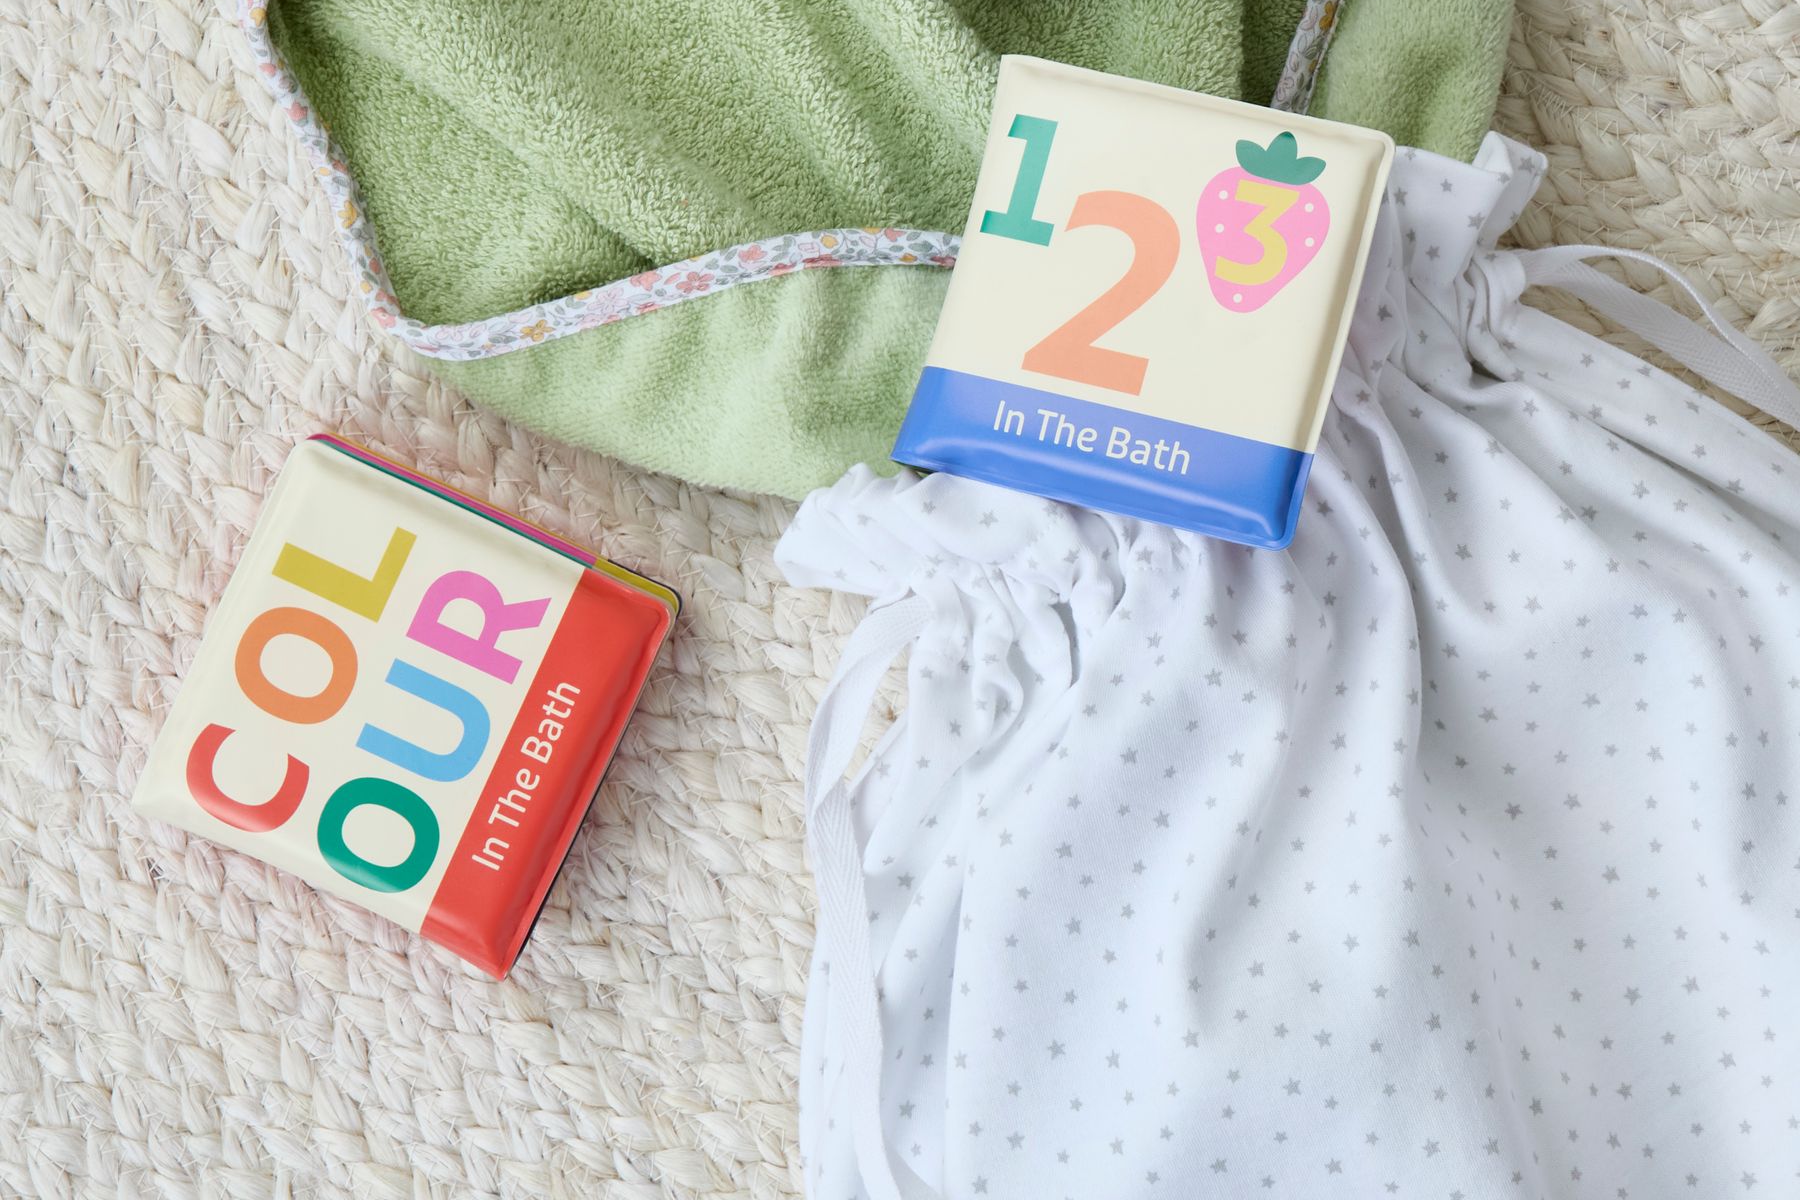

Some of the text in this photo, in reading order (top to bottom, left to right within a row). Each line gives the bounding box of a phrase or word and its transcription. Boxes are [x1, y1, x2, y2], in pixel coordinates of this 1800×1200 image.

[979, 113, 1059, 247] 1
[1214, 179, 1300, 286] 3
[1021, 190, 1181, 397] 2
[993, 401, 1191, 474] In The Bath
[186, 526, 418, 833] COL
[317, 570, 552, 893] OUR
[471, 681, 581, 872] In The Bath
